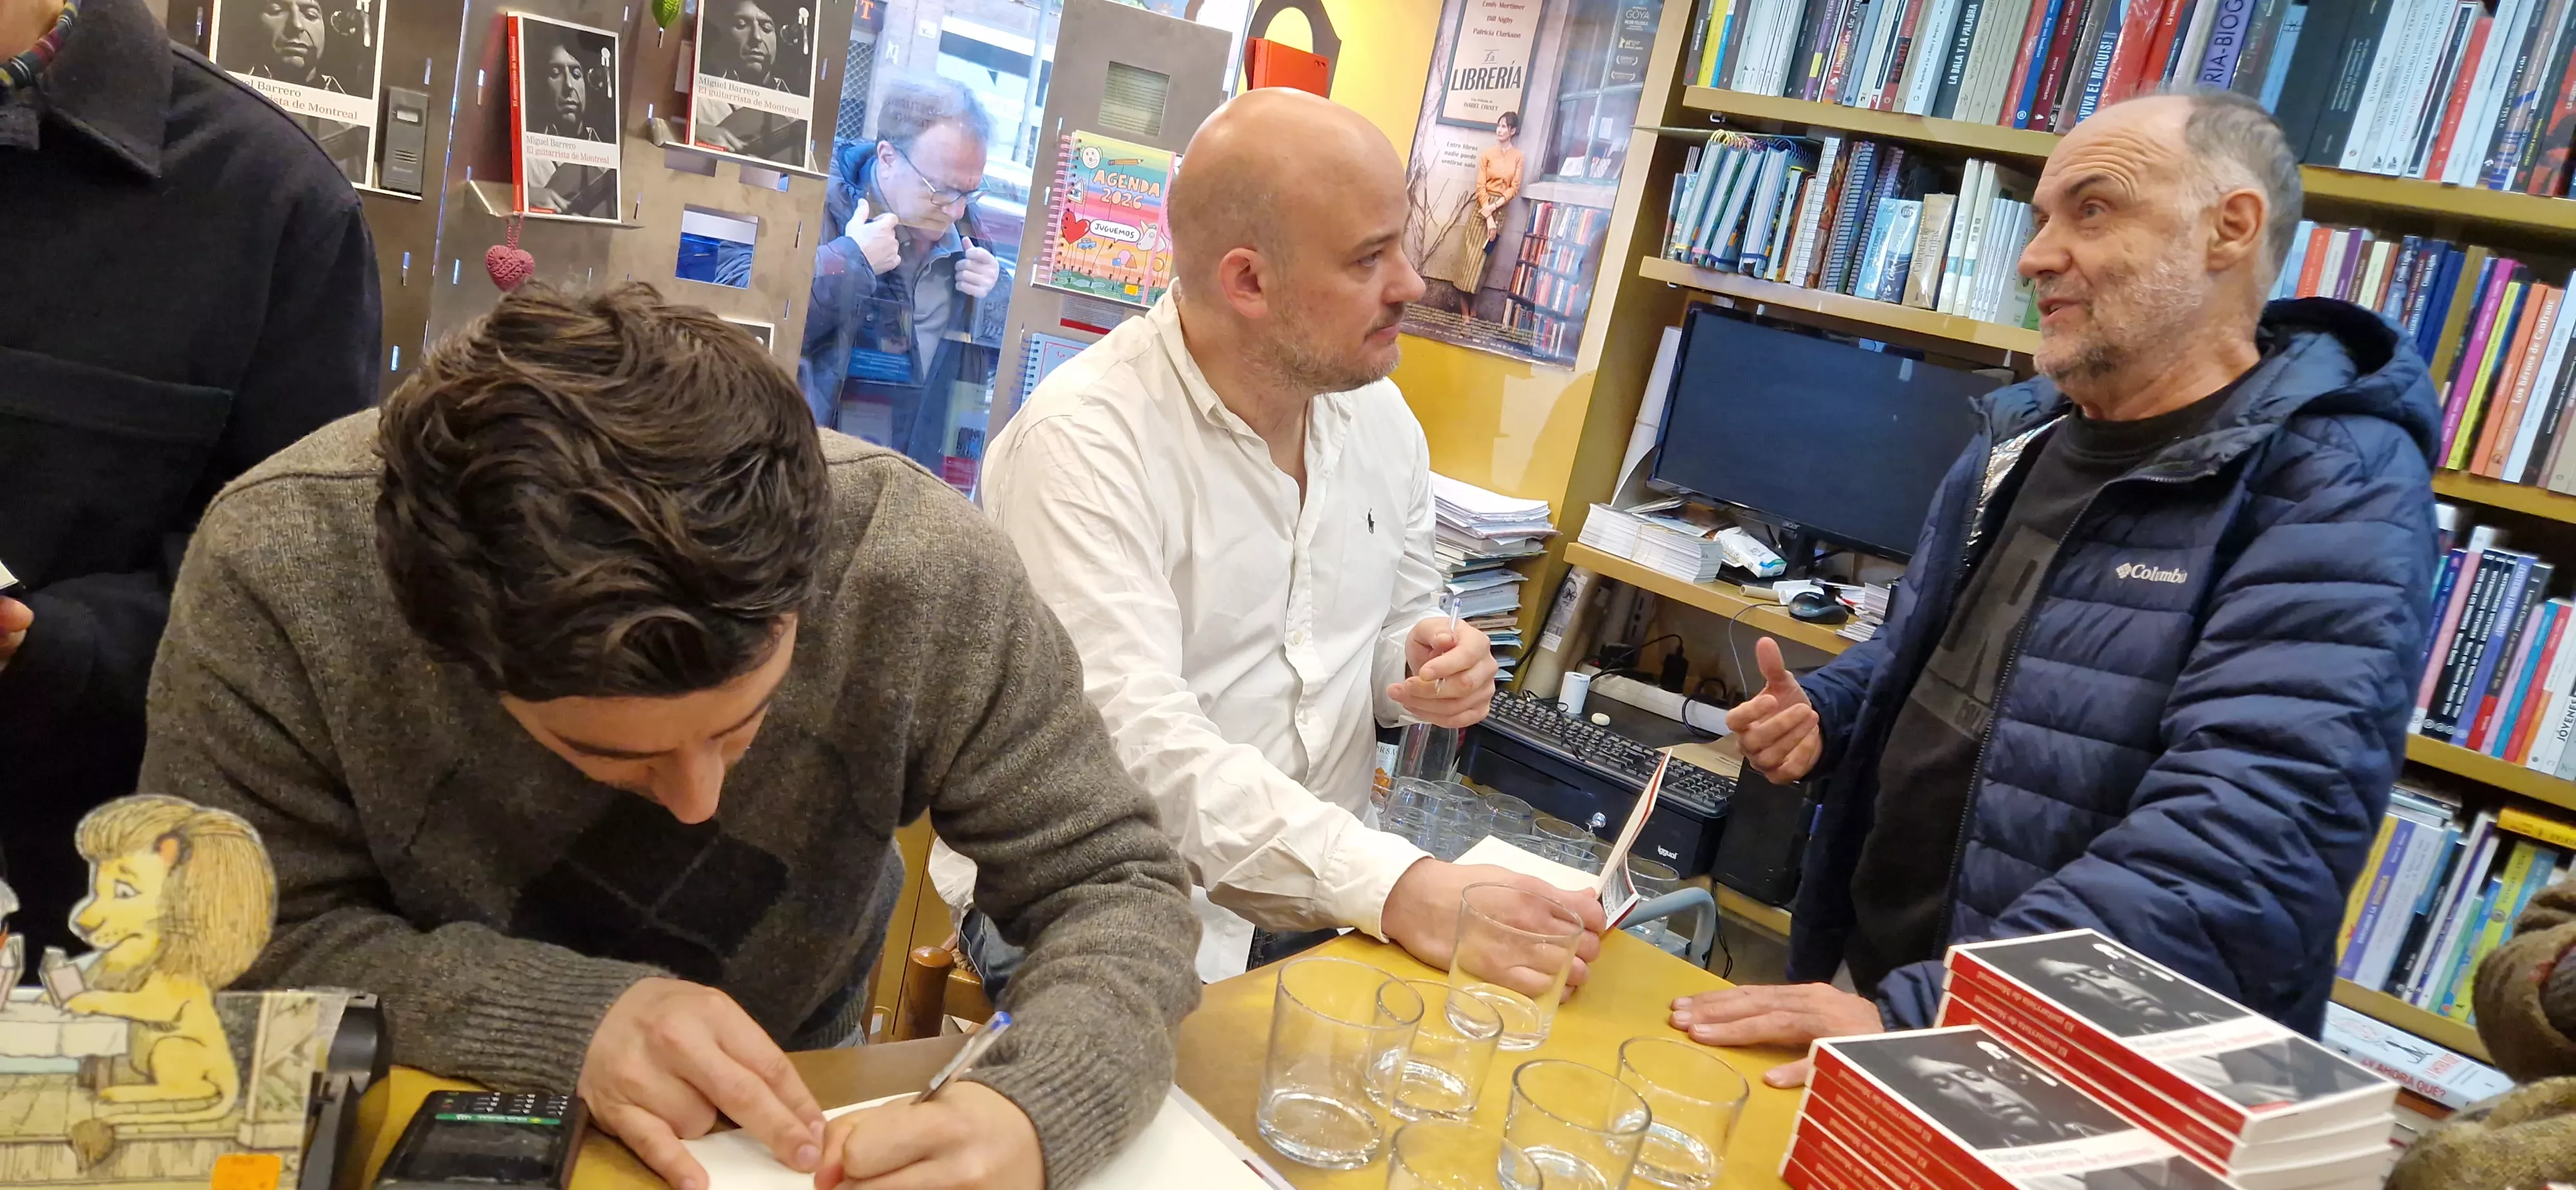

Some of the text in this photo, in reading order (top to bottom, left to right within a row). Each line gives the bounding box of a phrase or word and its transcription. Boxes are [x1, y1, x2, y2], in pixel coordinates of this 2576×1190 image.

[1482, 1, 1525, 11] Emily Mortimer
[1626, 10, 1649, 20] GOYA
[1497, 15, 1513, 24] Nighy
[1960, 2, 1978, 37] PALABRA
[1473, 28, 1521, 39] Patricia Clarkson
[1958, 35, 1969, 48] LA
[2204, 0, 2245, 85] RIA-BIOG
[1833, 31, 1852, 74] Libertarias
[1846, 18, 1855, 28] de
[2401, 55, 2416, 86] HISTORIA
[2417, 21, 2427, 40] SIGLO
[2423, 12, 2430, 21] XX
[1484, 51, 1495, 62] La
[1951, 53, 1964, 74] BALA
[2092, 39, 2111, 80] MAQUIS!
[1450, 61, 1521, 91] LIBRERÍA
[1947, 73, 1958, 86] LA
[2087, 79, 2099, 93] EL
[258, 80, 301, 98] Barrero
[699, 77, 760, 97] Miguel Barrero
[292, 100, 357, 120] de Montreal
[698, 86, 799, 115] El guitarrista de Montreal
[526, 135, 576, 149] Miguel Barrero
[1446, 141, 1461, 150] Entre
[526, 146, 533, 154] El
[535, 147, 570, 158] guitarrista
[580, 153, 609, 164] Montreal
[1441, 158, 1463, 167] sentirse
[1092, 169, 1160, 198] AGENDA
[1101, 187, 1144, 210] 2026
[1094, 223, 1135, 239] JUGUEMOS
[2512, 298, 2555, 404] Los héroes de Canfranc
[1782, 521, 1801, 529] acer
[1657, 845, 1678, 859] iggual
[1975, 970, 2075, 1032] El guitarrista de Montreal
[1971, 995, 2068, 1057] El guitarrista de Montreal
[2376, 1062, 2414, 1086] AHORA
[1837, 1068, 1933, 1142] El guitarrista de Montreal
[1833, 1093, 1928, 1167] El guitarrista de Montreal
